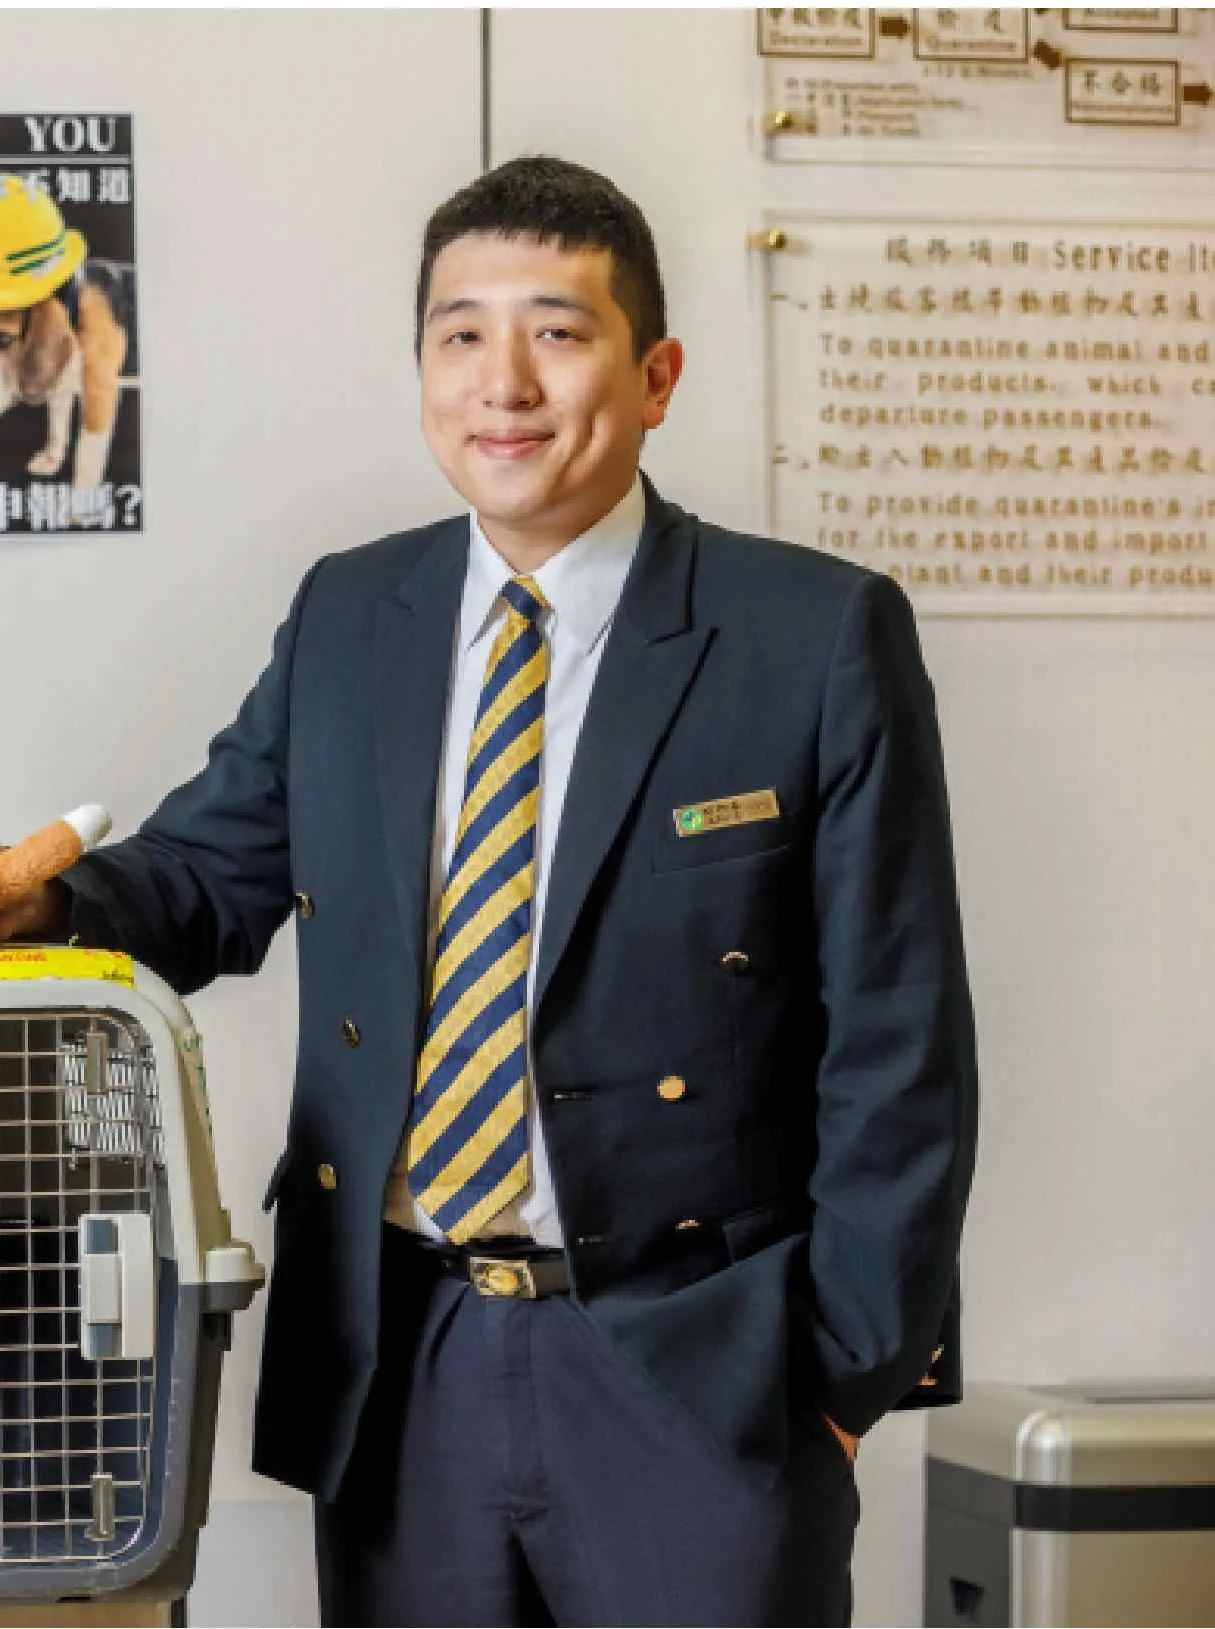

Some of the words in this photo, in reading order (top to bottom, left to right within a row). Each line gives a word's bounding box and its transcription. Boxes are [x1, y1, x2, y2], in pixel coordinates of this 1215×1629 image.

[24, 116, 117, 153] YOU
[1052, 240, 1170, 274] Service
[819, 332, 853, 356] To
[868, 335, 1030, 361] quarantine
[1046, 338, 1141, 362] animal
[1158, 341, 1210, 364] and
[1087, 373, 1161, 395] which
[819, 403, 968, 430] departure
[819, 490, 851, 514] To
[1046, 530, 1097, 551] and
